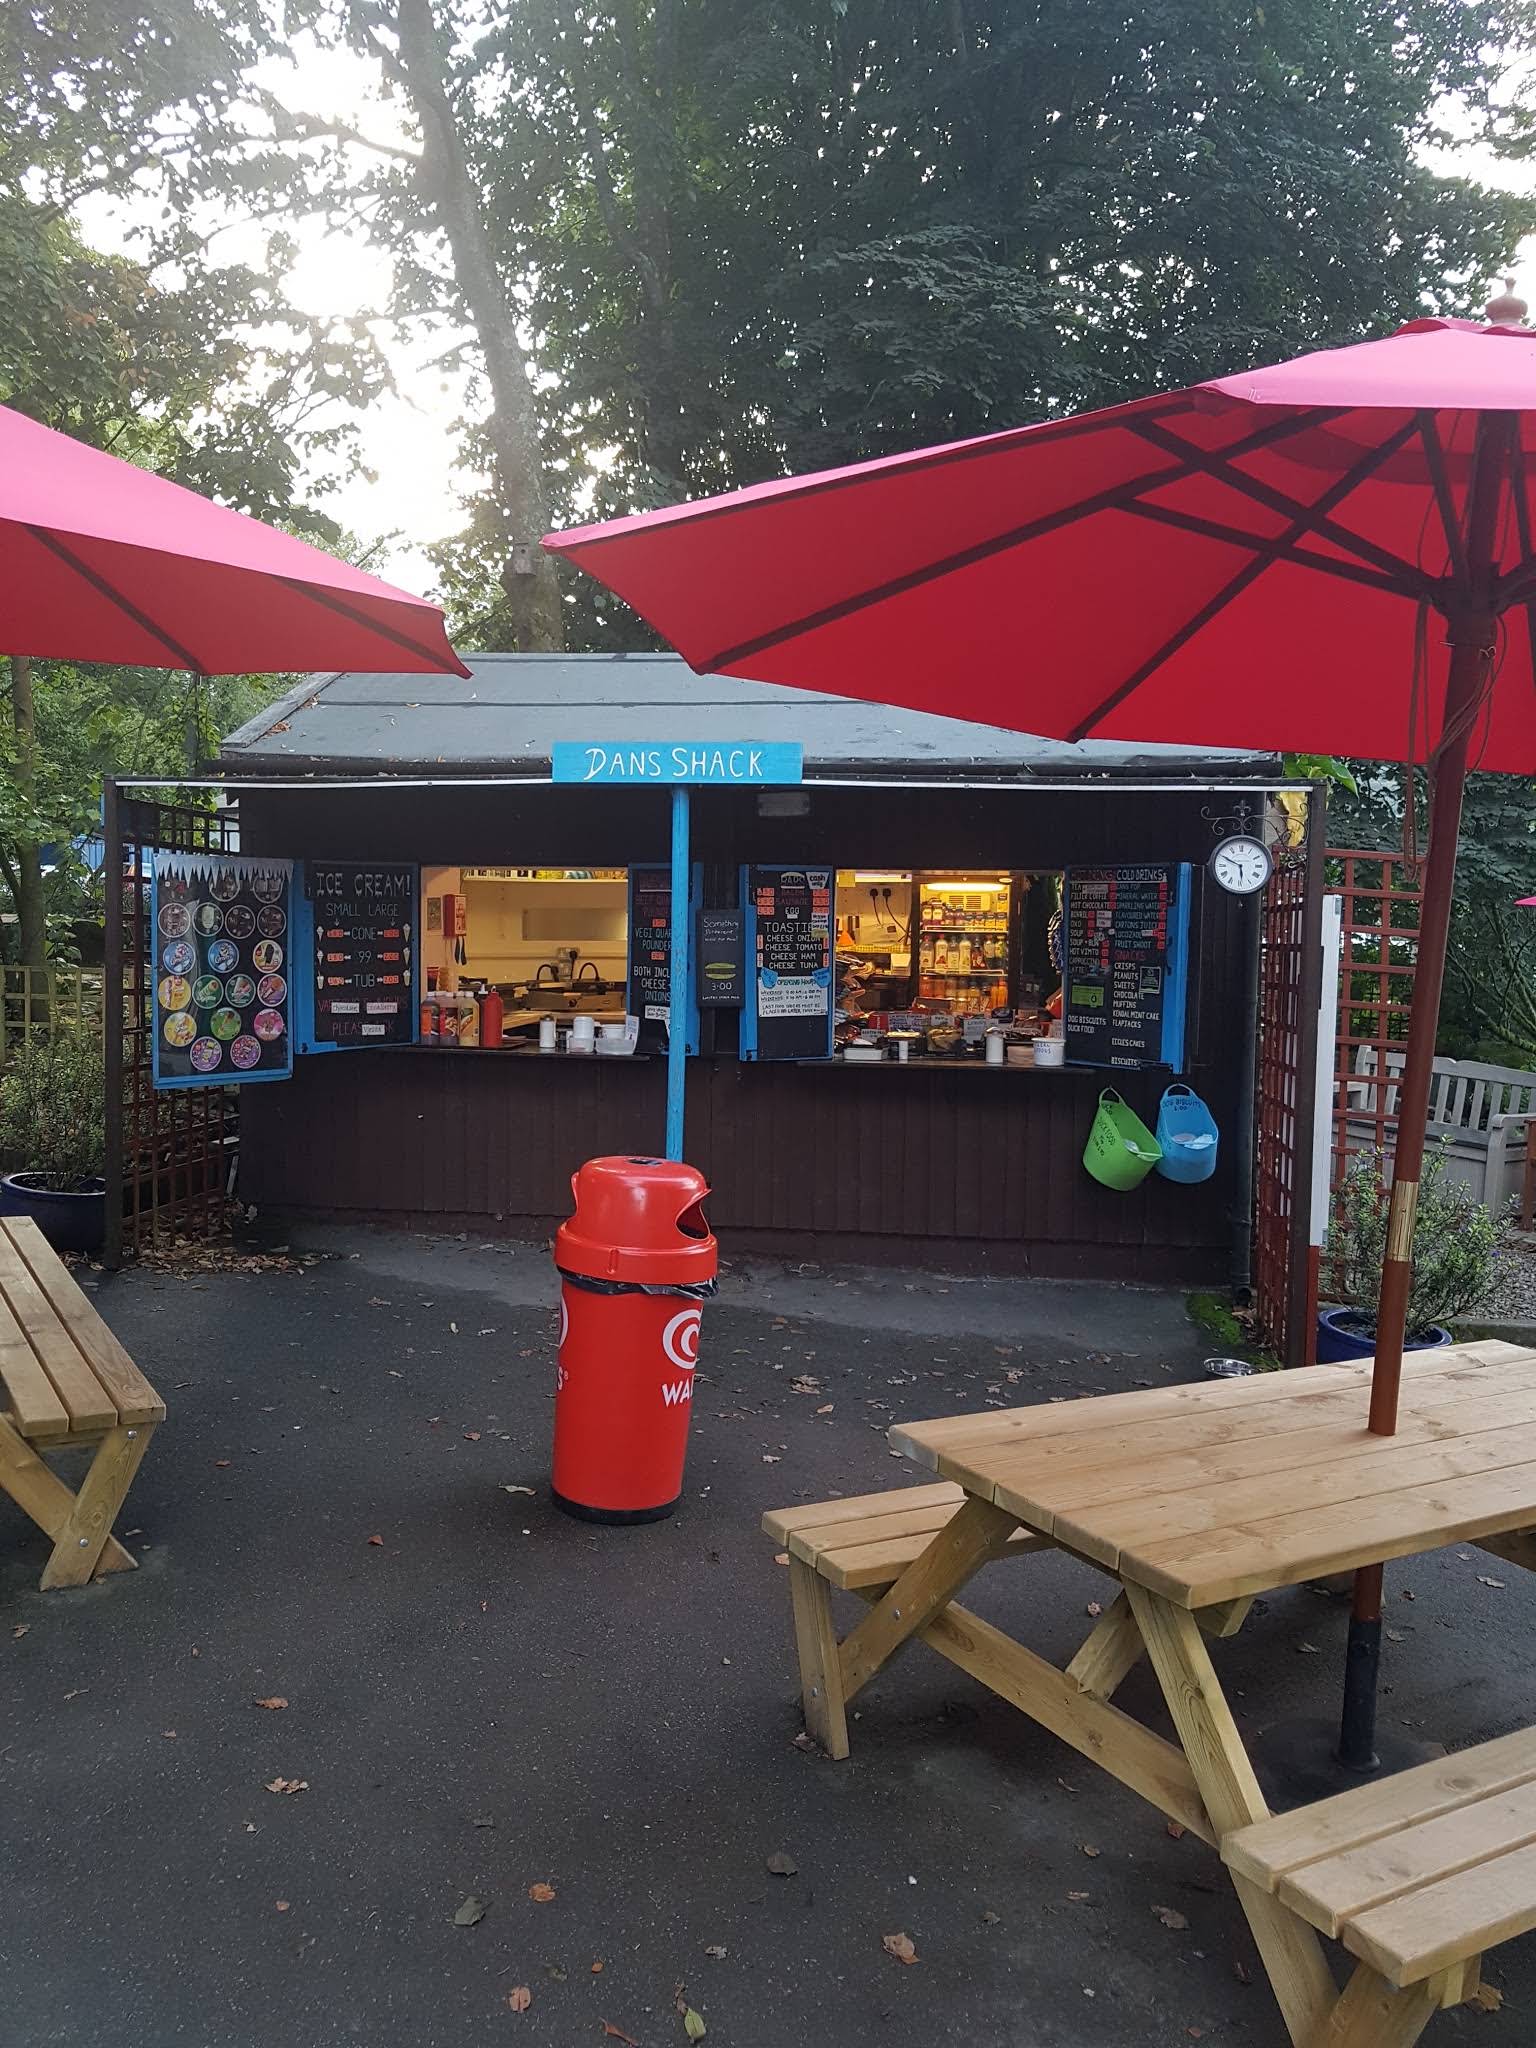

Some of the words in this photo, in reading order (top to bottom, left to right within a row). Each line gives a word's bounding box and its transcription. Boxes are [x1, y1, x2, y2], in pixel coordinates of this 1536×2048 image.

[584, 748, 661, 780] DANS
[672, 747, 763, 777] SHACK
[1116, 869, 1134, 880] COLD
[1136, 868, 1163, 880] DRINKS
[316, 872, 343, 896] ICE
[354, 874, 411, 897] CREAM!
[1082, 901, 1110, 909] CHOCOLATE
[326, 903, 360, 917] SMALL
[368, 903, 400, 917] LARGE
[785, 907, 799, 915] EGG
[351, 927, 377, 940] CONE
[635, 928, 652, 938] VEGI
[766, 934, 794, 942] CHEESE
[765, 943, 791, 951] CHEESE
[796, 943, 823, 951] TOMATO
[1115, 940, 1132, 948] FRUIT
[358, 951, 372, 963] 99
[770, 952, 797, 960] CHEESE
[801, 952, 816, 960] HAM
[768, 961, 796, 969] CHEESE
[800, 961, 819, 969] TUNA
[1114, 962, 1136, 970] CRISPS
[633, 966, 650, 976] BOTH
[353, 974, 375, 987] TUB
[1113, 972, 1139, 980] PEANUTS
[641, 979, 666, 990] CHEESE
[1113, 981, 1135, 990] SWEETS
[1113, 991, 1145, 1000] CHOCOLATE
[1112, 1000, 1137, 1009] MUFFINS
[1067, 1015, 1079, 1023] DOG
[1079, 1016, 1107, 1025] BISCUITS
[1130, 1011, 1145, 1019] MINT
[1146, 1012, 1160, 1020] CAKE
[1112, 1019, 1142, 1028] FLAPJACKS
[1111, 1056, 1138, 1066] BISCUITS
